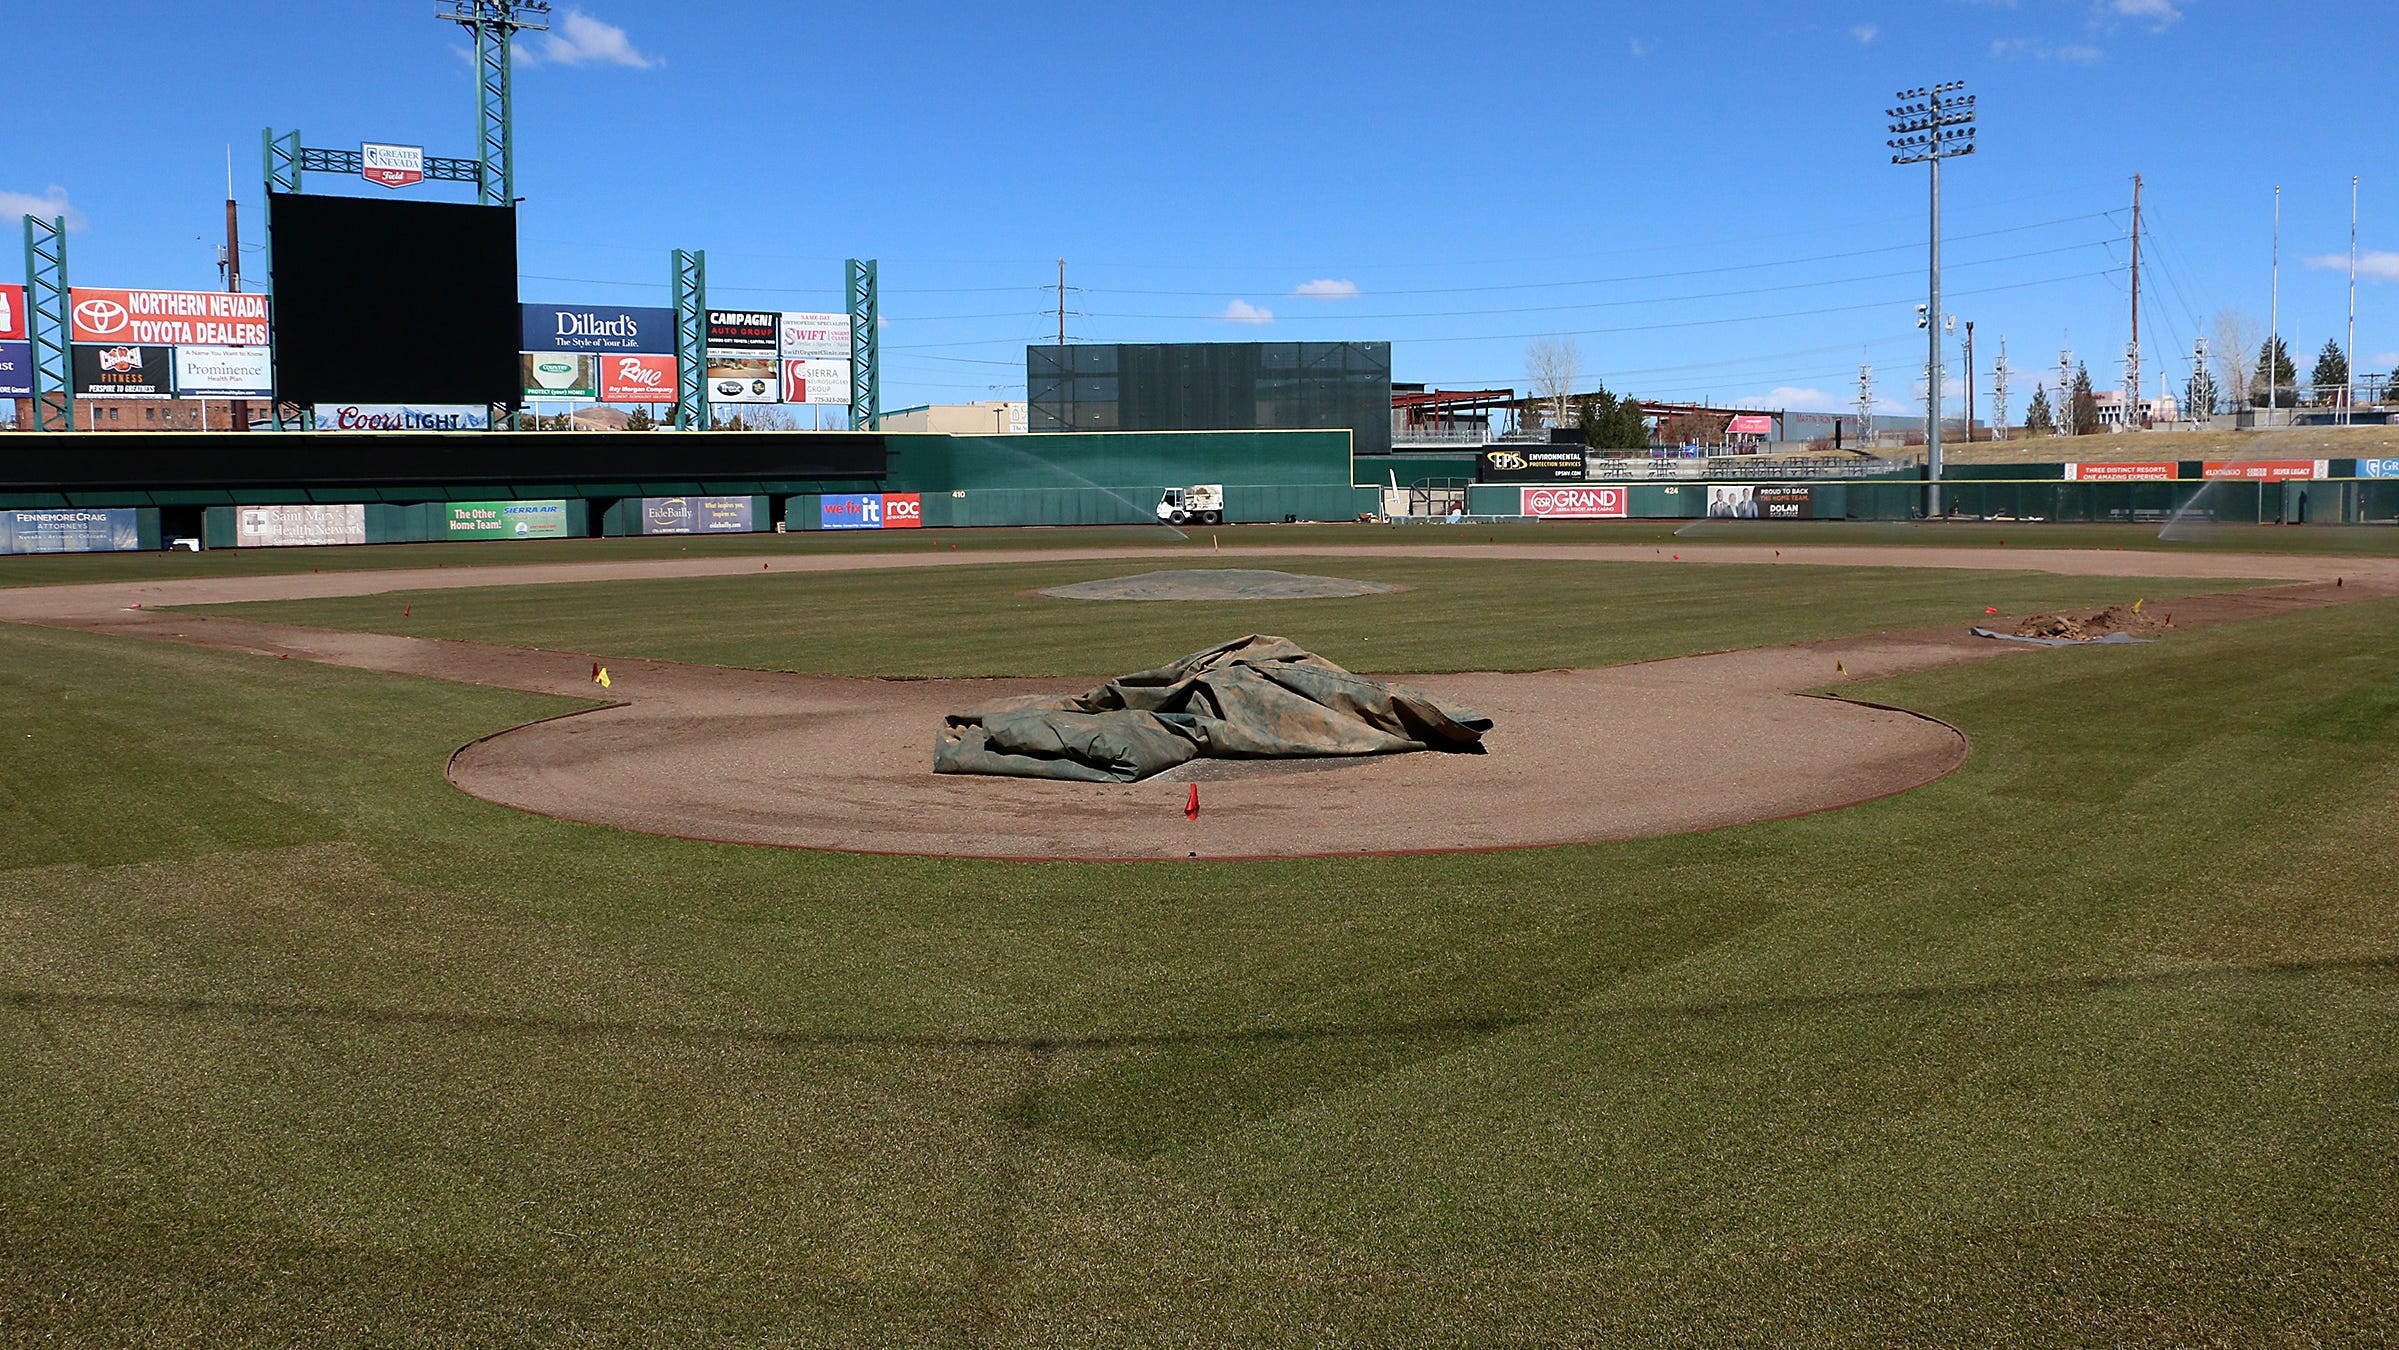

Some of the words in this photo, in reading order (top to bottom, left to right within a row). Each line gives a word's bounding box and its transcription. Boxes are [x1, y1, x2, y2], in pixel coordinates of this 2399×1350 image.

[378, 149, 419, 160] GREATER
[379, 157, 419, 168] NEVADA
[381, 171, 405, 181] Field
[128, 292, 207, 317] NORTHERN
[210, 295, 265, 319] NEVADA
[555, 312, 637, 336] Dillard's
[710, 312, 773, 327] CAMPAGNI
[130, 320, 192, 343] TOYOTA
[196, 322, 266, 345] DEALERS
[711, 327, 738, 335] AUTO
[740, 328, 774, 336] GROUP
[784, 327, 827, 345] SWIFT
[555, 337, 571, 347] The
[572, 338, 593, 349] Style
[593, 338, 601, 347] of
[602, 339, 621, 348] Your
[622, 339, 639, 348] Life.
[99, 348, 143, 370] CRUNCH
[188, 362, 262, 376] Prominence
[806, 368, 839, 378] SIERRA
[101, 374, 143, 383] FITNESS
[89, 384, 116, 393] PERSPIRE
[116, 384, 124, 393] TO
[125, 385, 156, 393] GREATNESS
[608, 385, 622, 393] Ray
[622, 386, 646, 394] Morgan
[646, 386, 674, 394] Company
[720, 383, 741, 393] Trex
[336, 405, 404, 430] Coors
[405, 413, 460, 429] LIGHT
[1495, 452, 1520, 469] EPS
[1529, 453, 1581, 461] ENVIRONMENTAL
[2290, 467, 2311, 475] LEGACY
[952, 490, 966, 498] 410
[1663, 487, 1679, 495] 424
[1791, 487, 1809, 495] BACK
[1533, 497, 1551, 508] GSR
[1554, 490, 1617, 507] GRAND
[453, 508, 472, 519] The
[472, 508, 497, 519] Other
[504, 506, 539, 514] SIERRA
[540, 505, 558, 513] AIR
[824, 504, 843, 514] we
[845, 501, 862, 514] fix
[862, 496, 880, 522] it
[886, 501, 920, 516] roc
[1769, 504, 1799, 512] DOLAN
[16, 513, 76, 522] FENNEMORE
[76, 512, 107, 522] CRAIG
[271, 509, 302, 521] Saint
[271, 524, 312, 536] Health
[314, 523, 363, 535] Network
[449, 519, 475, 530] Home
[475, 519, 502, 530] Team!
